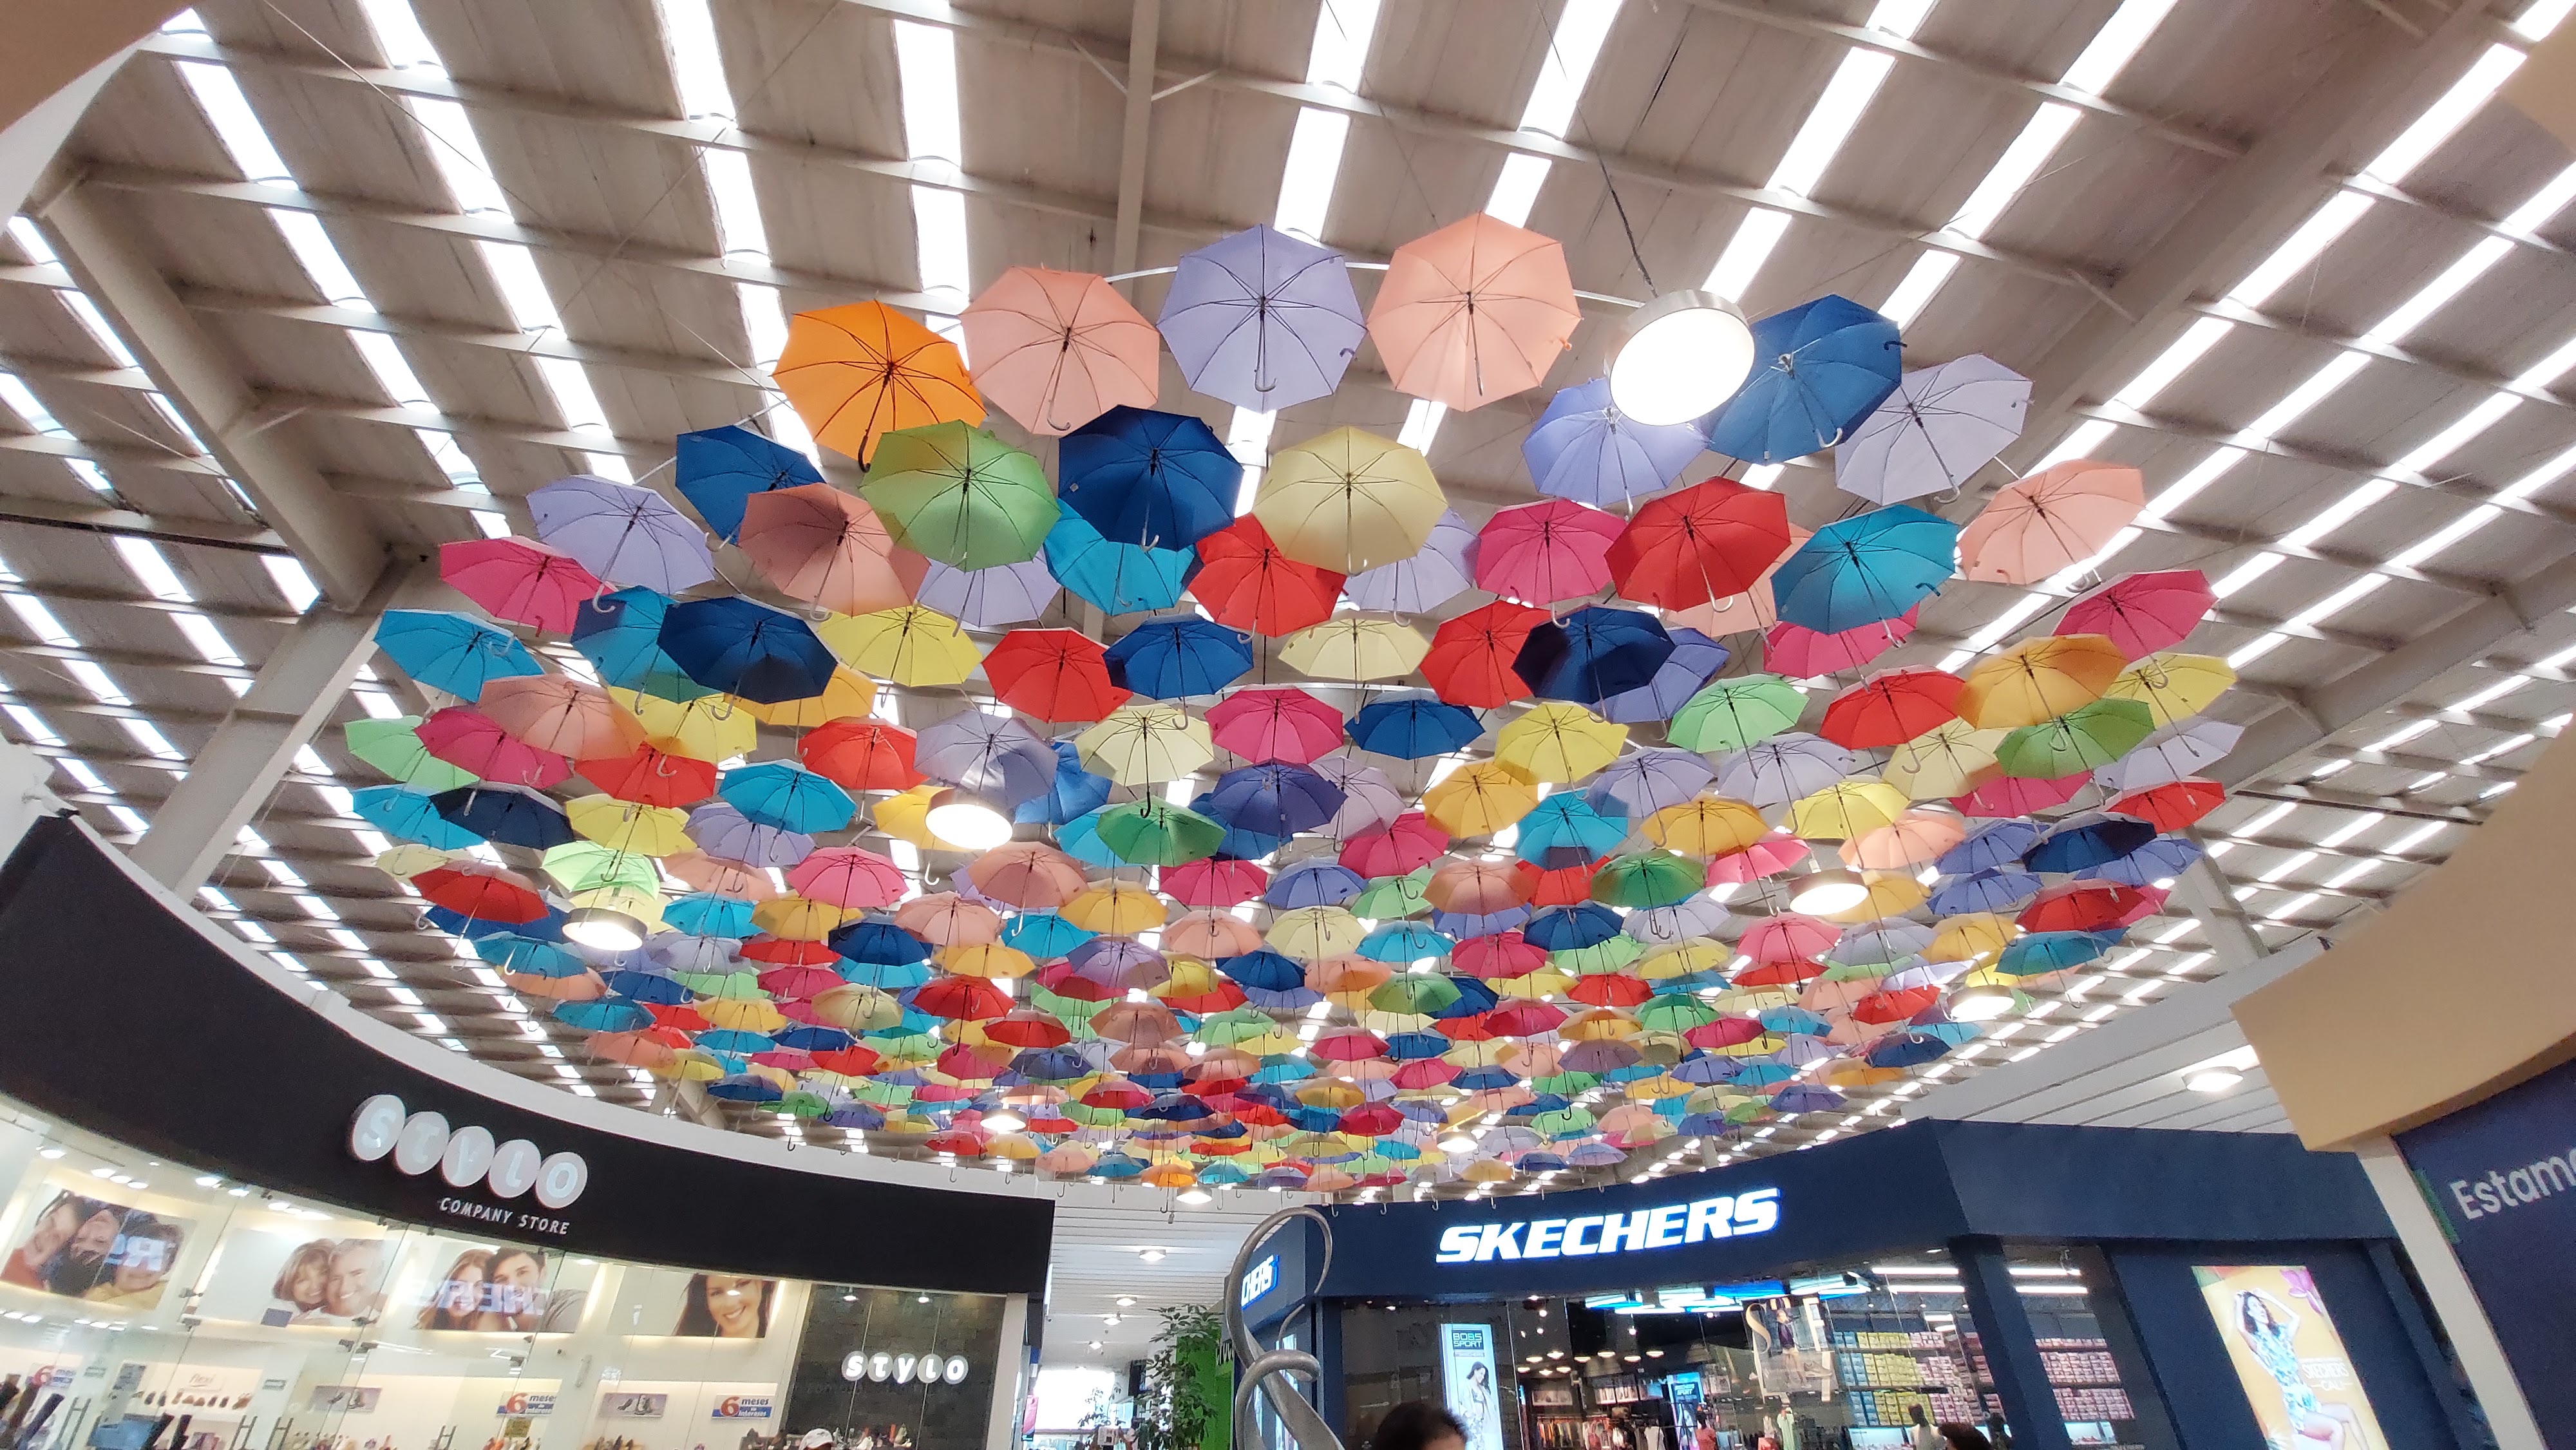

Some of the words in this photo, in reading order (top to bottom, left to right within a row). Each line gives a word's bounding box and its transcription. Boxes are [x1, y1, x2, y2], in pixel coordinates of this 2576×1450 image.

[439, 1197, 513, 1224] COMPANY
[518, 1214, 570, 1235] STORE
[1435, 1188, 1781, 1263] SKECHERS
[1241, 1255, 1279, 1310] CHERS
[846, 1355, 965, 1384] STYLO
[2302, 1362, 2349, 1379] SKECHERS
[507, 1393, 529, 1414] 6
[721, 1396, 741, 1417] 6
